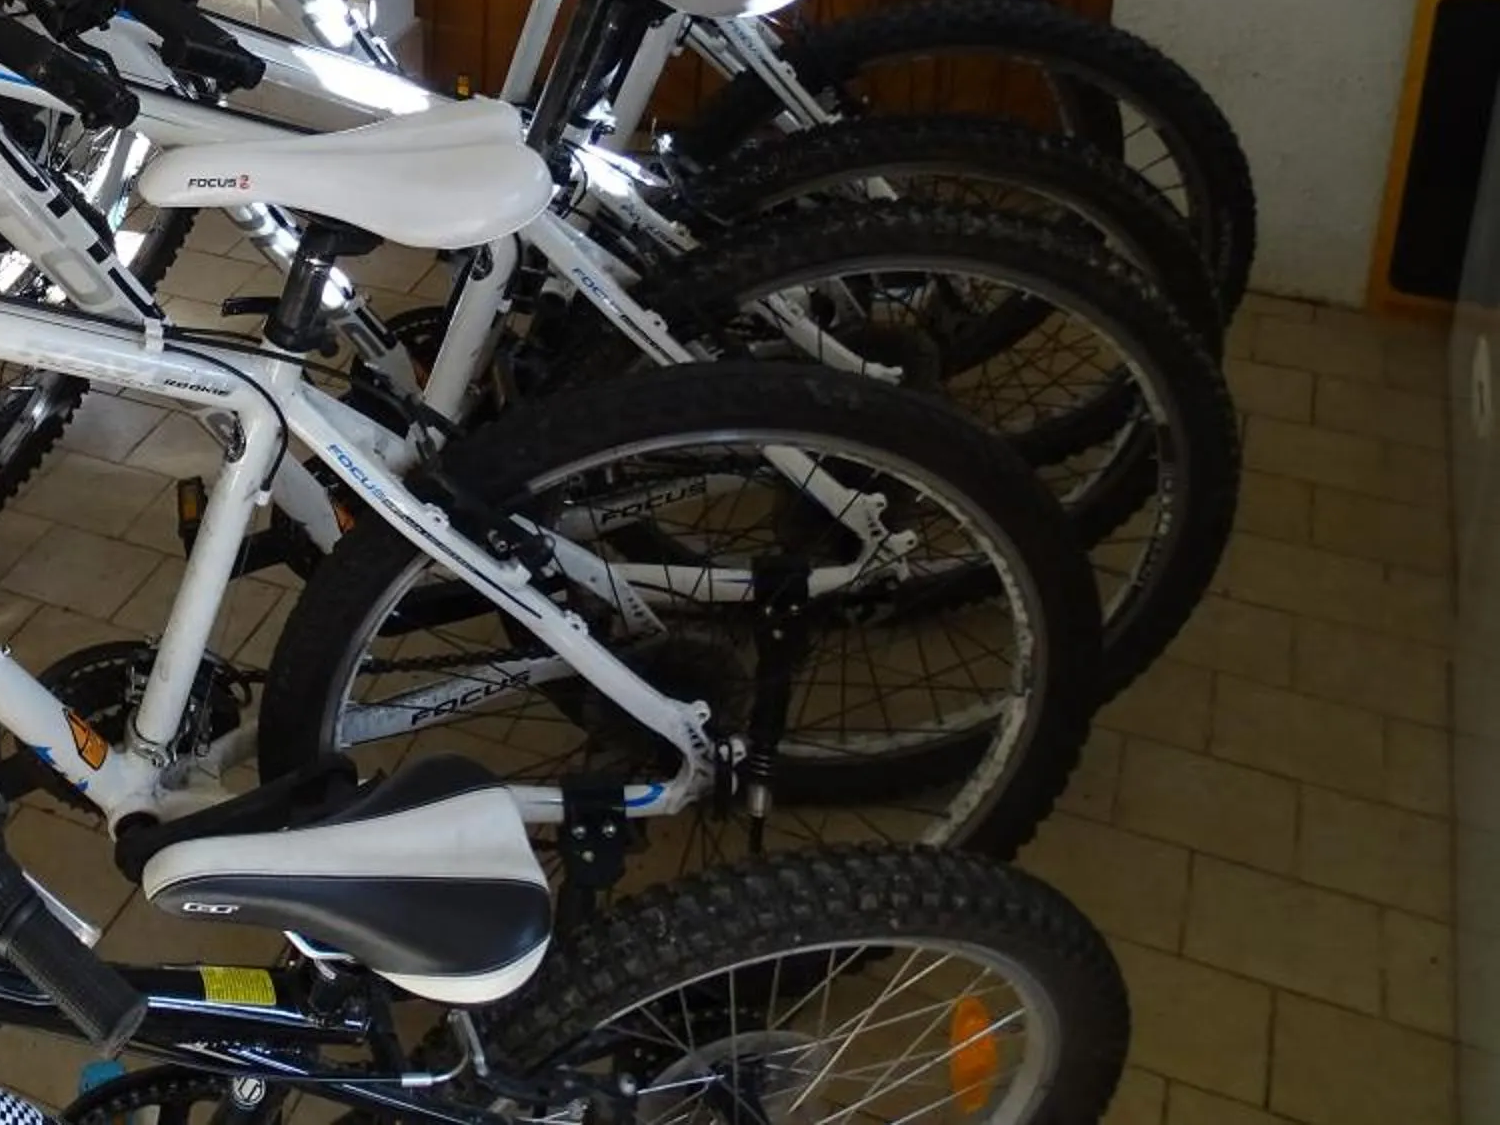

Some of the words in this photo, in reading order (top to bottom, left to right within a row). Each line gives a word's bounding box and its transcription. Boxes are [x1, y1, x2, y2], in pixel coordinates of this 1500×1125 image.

[187, 176, 237, 189] FOCUS
[163, 379, 230, 397] ROOKIE
[326, 443, 388, 507] FOCUS
[410, 671, 532, 725] FOCUS
